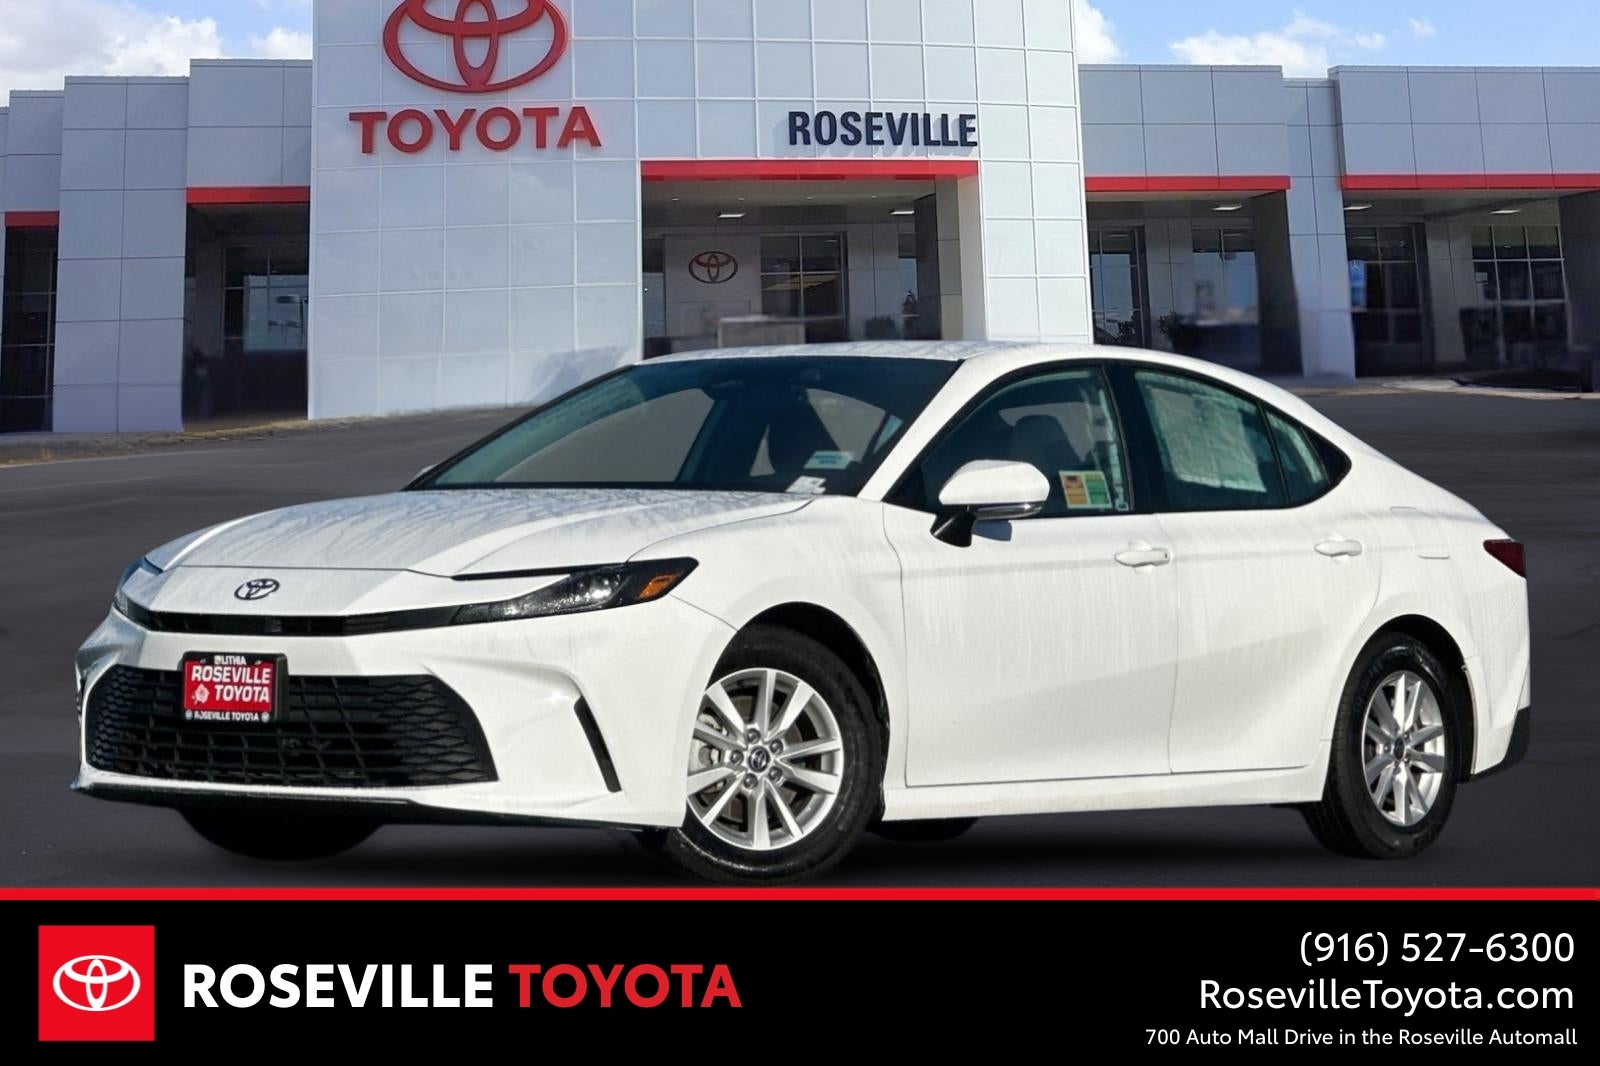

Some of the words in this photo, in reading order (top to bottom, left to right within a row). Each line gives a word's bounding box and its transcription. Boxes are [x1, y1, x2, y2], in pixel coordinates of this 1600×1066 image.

[349, 106, 602, 154] TOYOTA
[788, 110, 978, 147] ROSEVILLE
[191, 665, 272, 684] ROSEVILLE
[214, 685, 270, 702] TOYOTA
[231, 711, 259, 722] TOYOTA
